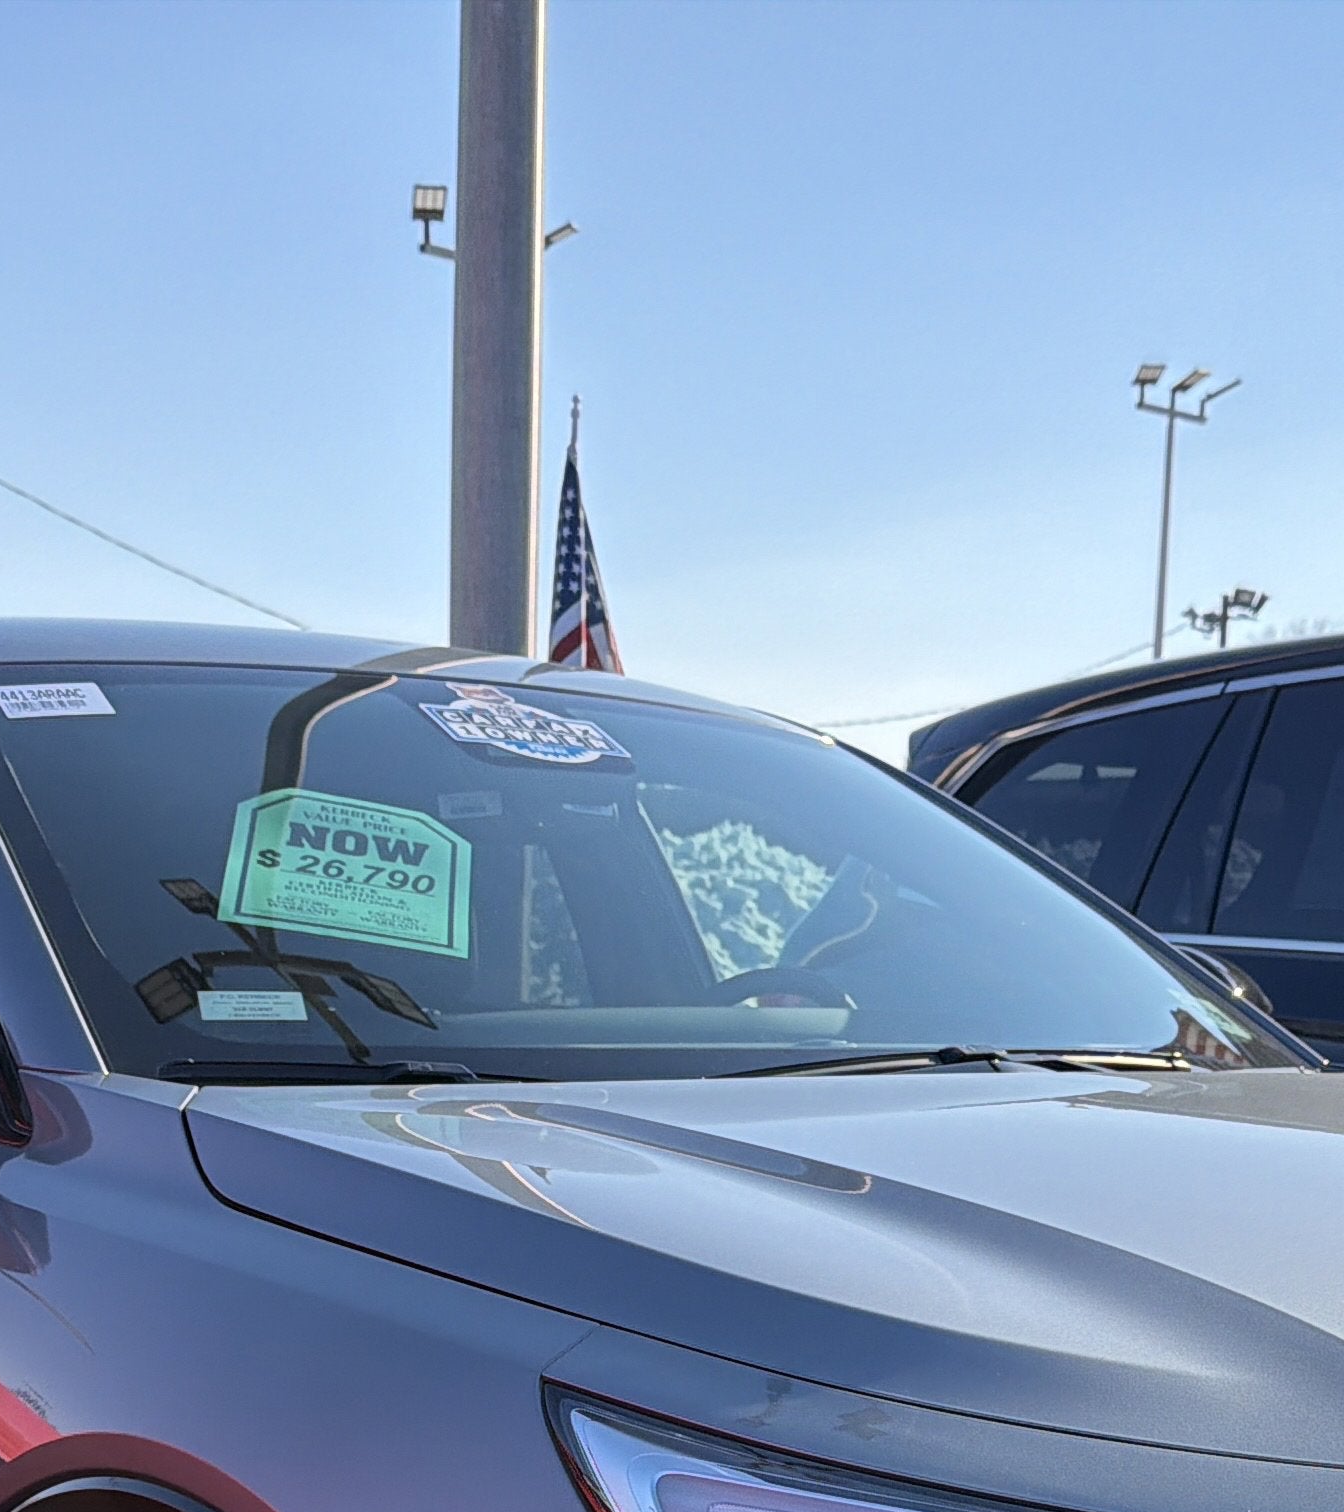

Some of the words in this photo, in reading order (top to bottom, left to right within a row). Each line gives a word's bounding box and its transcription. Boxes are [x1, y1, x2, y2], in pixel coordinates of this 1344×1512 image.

[484, 728, 610, 749] OWNER
[303, 811, 351, 827] VALUE
[363, 820, 408, 836] PRICE
[320, 805, 391, 823] KERBECK
[286, 822, 430, 867] NOW
[256, 849, 281, 868] $
[295, 854, 436, 895] 26,790
